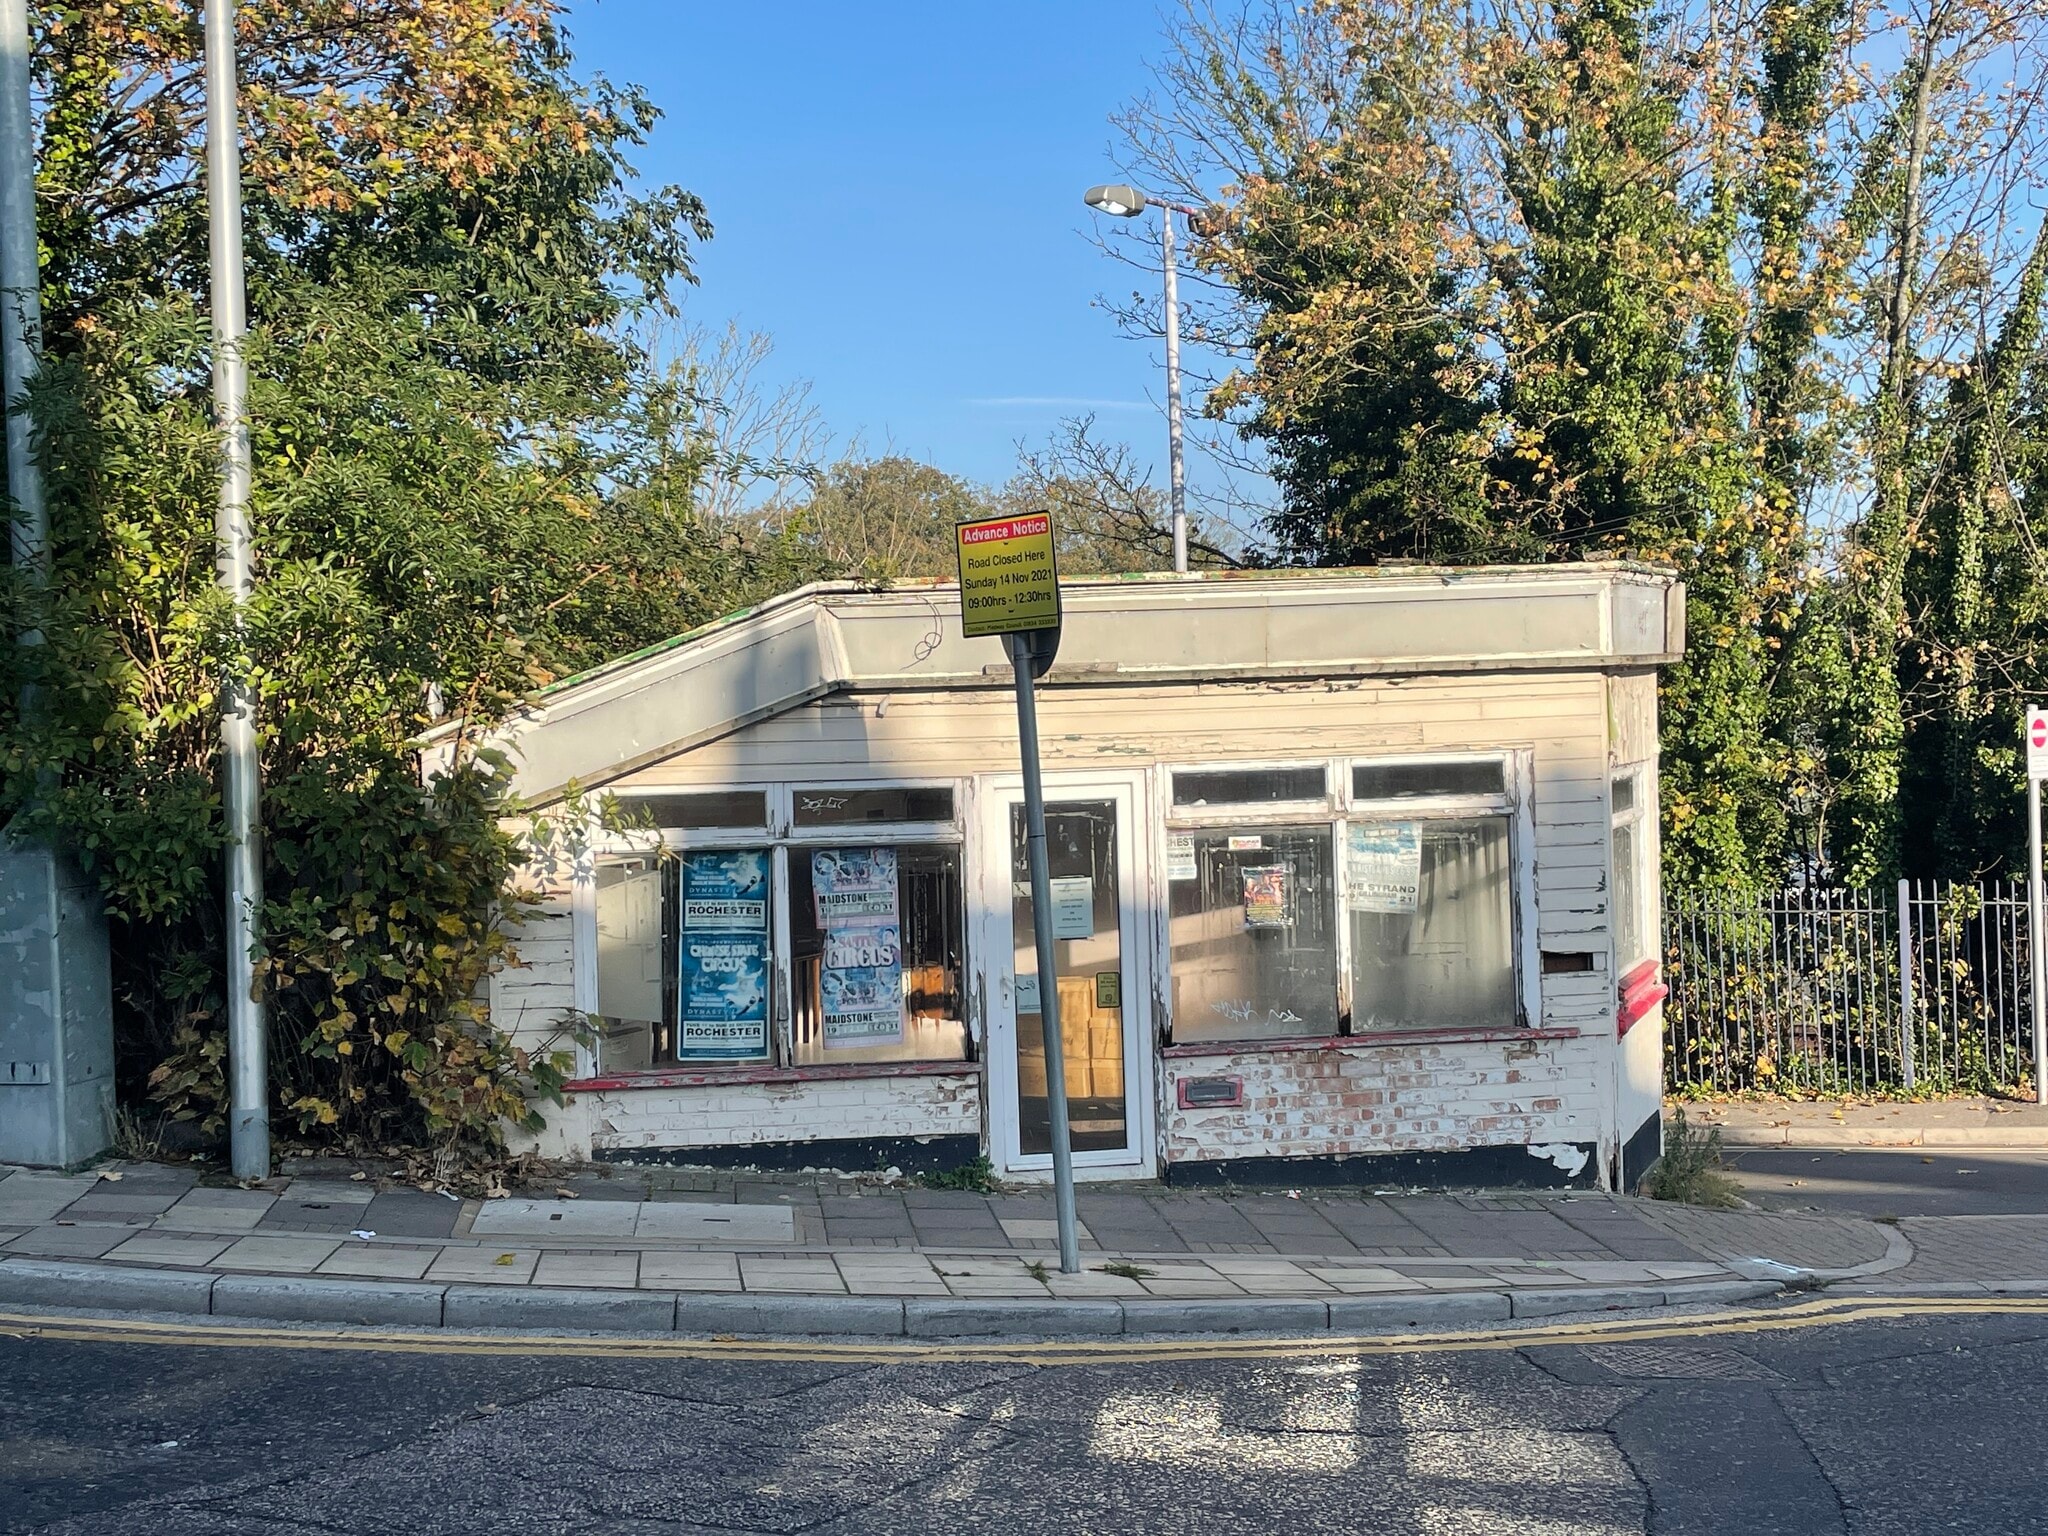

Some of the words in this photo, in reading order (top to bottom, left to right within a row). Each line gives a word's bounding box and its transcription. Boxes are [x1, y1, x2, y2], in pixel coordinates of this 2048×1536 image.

[964, 527, 1009, 543] Advance
[1013, 520, 1047, 536] Notice
[968, 556, 991, 569] Road
[992, 552, 1023, 566] Closed
[1025, 550, 1046, 562] Here
[965, 575, 998, 590] Sunday
[999, 573, 1011, 586] 14
[1012, 572, 1029, 584] Nov
[1031, 569, 1053, 581] 2021
[968, 595, 1007, 609] 09:00hrs
[1014, 590, 1052, 604] 12:30hrs
[1348, 882, 1364, 890] HE
[1368, 883, 1416, 893] STRAND
[818, 892, 868, 905] MAIDSTONE
[688, 906, 761, 915] ROCHESTER
[701, 957, 748, 973] CIRCUS
[827, 946, 894, 969] CIRCUS
[825, 1012, 873, 1024] MAIDSTONE
[686, 1027, 761, 1036] ROCHESTER
